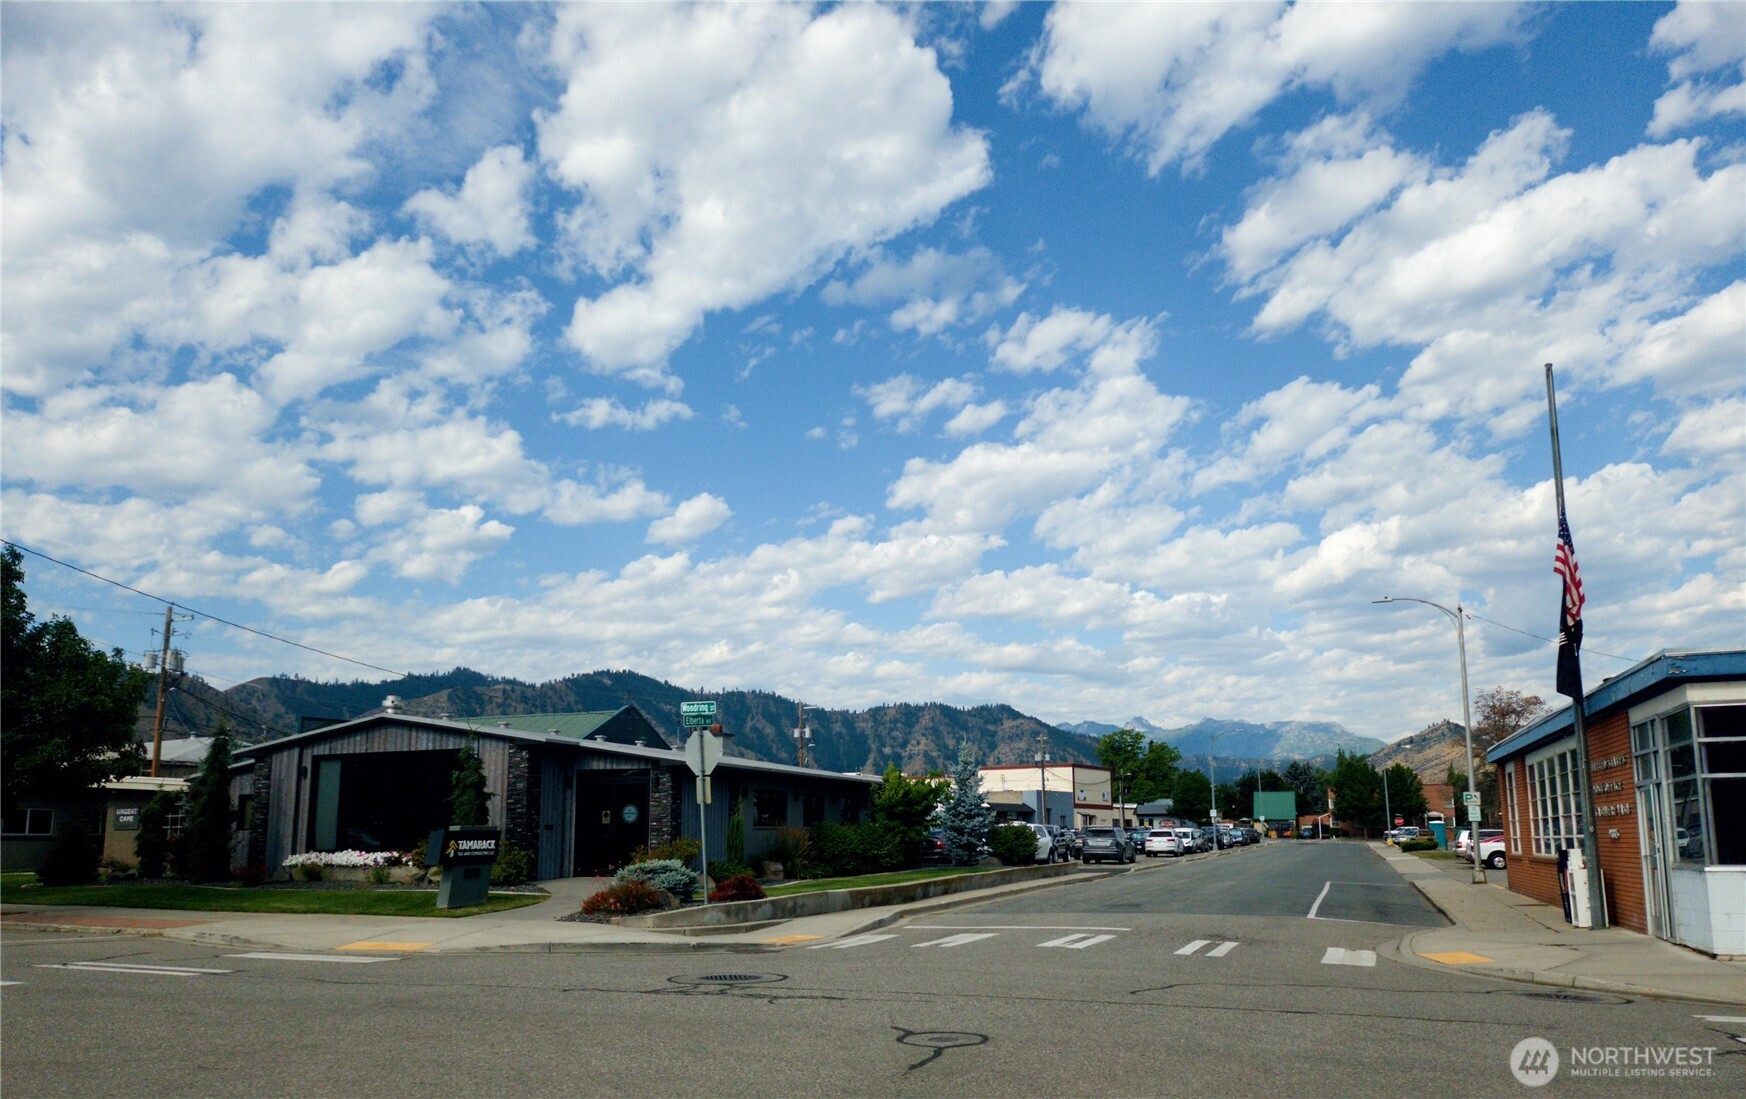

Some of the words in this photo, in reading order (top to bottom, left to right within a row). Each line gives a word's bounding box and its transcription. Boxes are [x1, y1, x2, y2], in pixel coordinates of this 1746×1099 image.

[682, 704, 708, 712] Woodring
[686, 716, 704, 724] Elberta
[1465, 794, 1472, 803] P
[458, 840, 496, 849] TAMARACK
